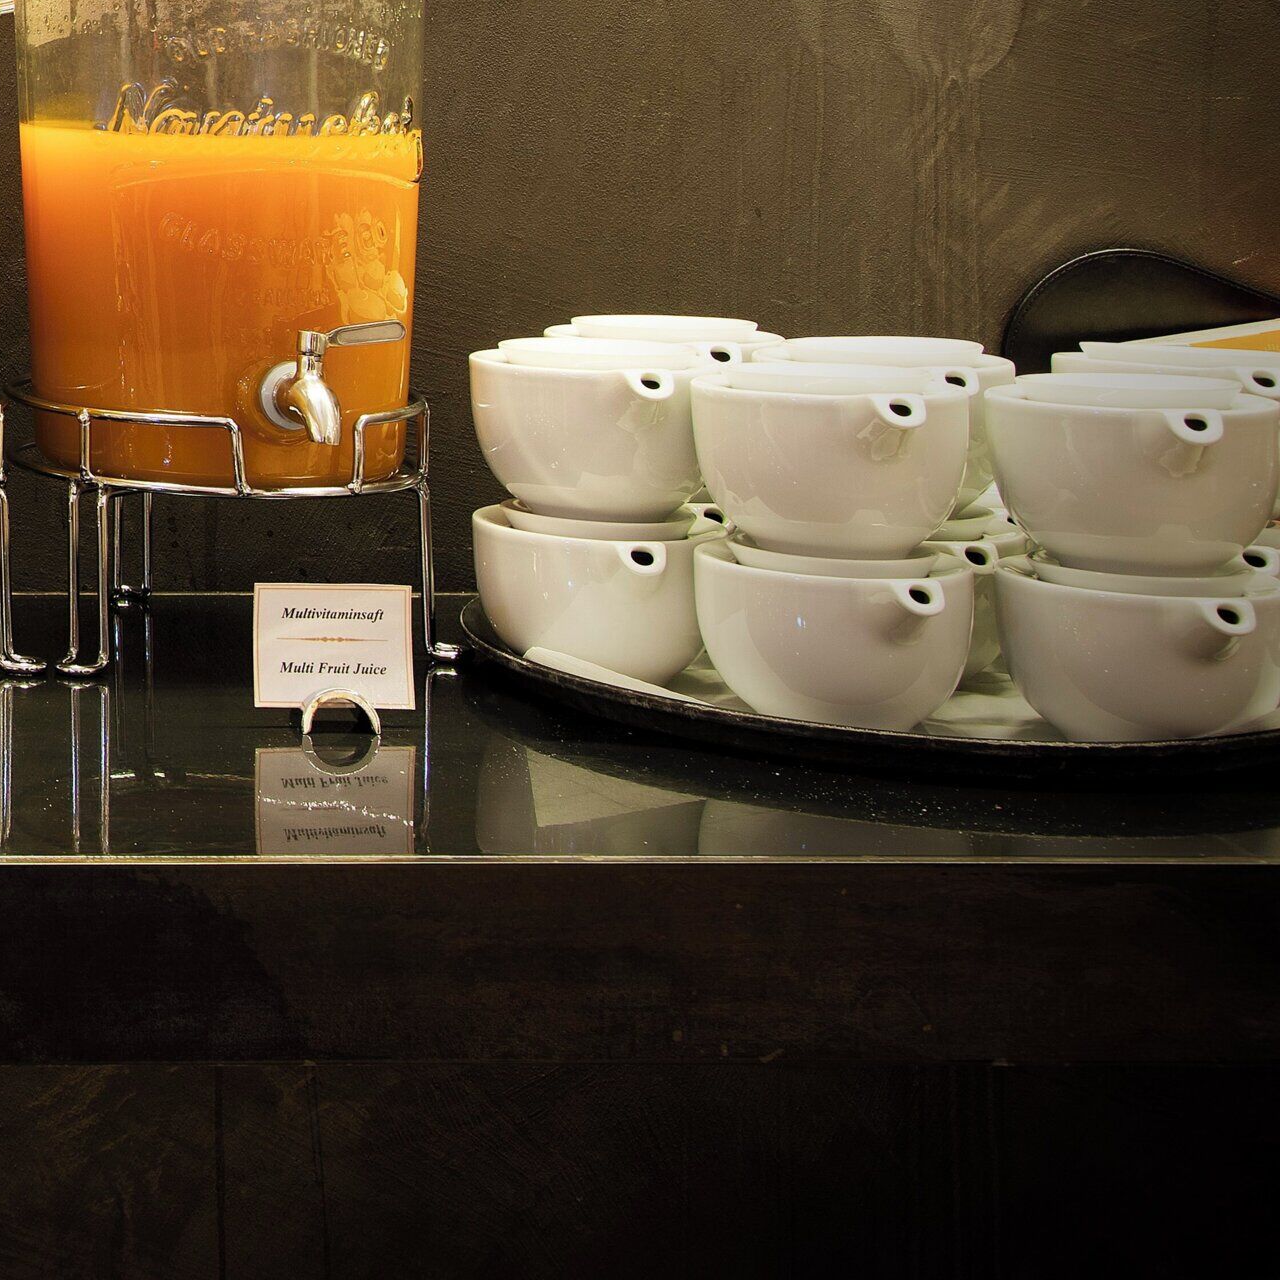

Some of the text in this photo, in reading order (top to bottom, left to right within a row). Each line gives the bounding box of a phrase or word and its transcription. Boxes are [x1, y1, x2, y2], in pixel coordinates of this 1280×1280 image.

[281, 606, 385, 622] Multivitaminsaft
[279, 660, 388, 675] Multi Fruit Juice
